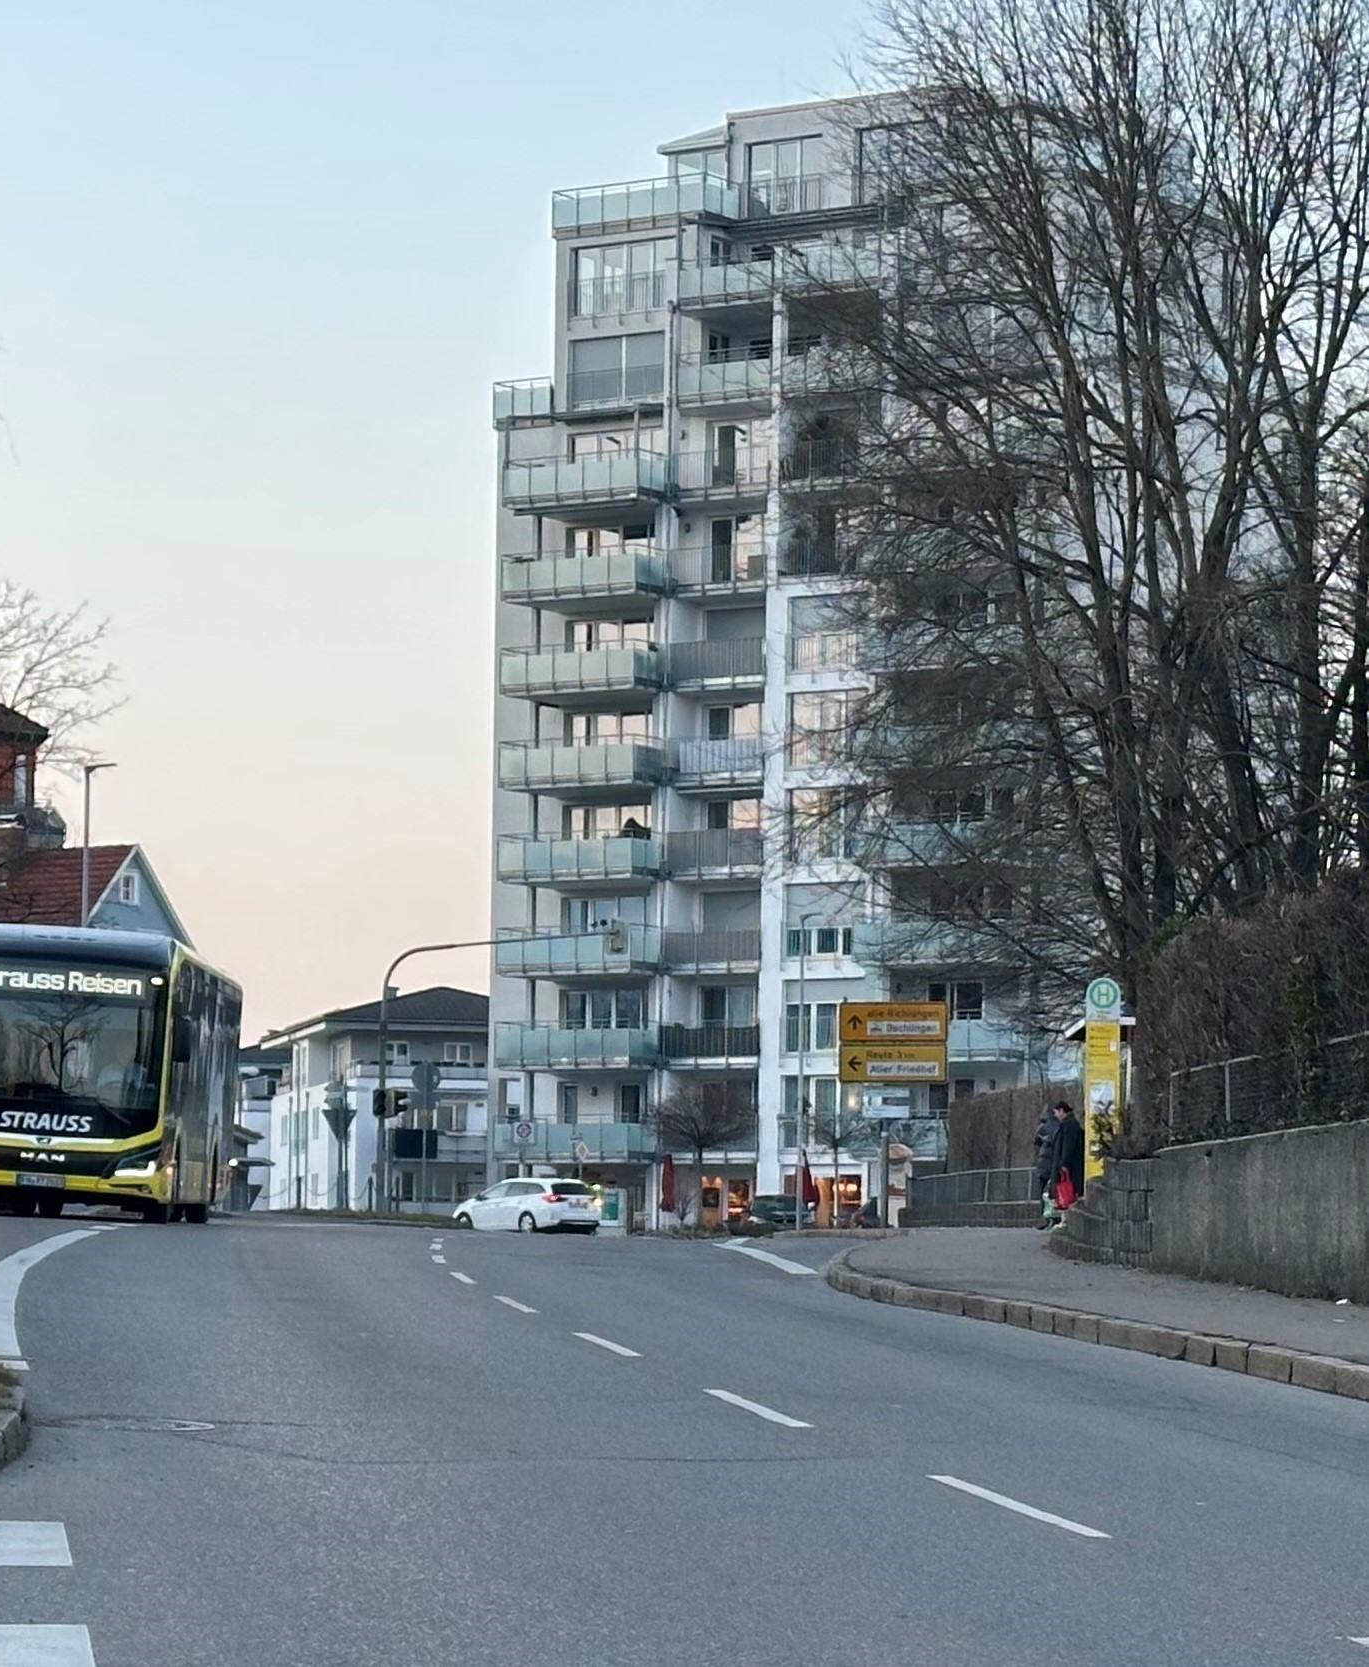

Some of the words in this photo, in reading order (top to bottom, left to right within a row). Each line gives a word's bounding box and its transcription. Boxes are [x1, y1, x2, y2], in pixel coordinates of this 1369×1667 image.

[68, 971, 142, 996] Reisen
[1097, 986, 1110, 1002] H
[896, 1064, 936, 1074] Friedhof
[0, 1110, 94, 1133] STRAUSS
[20, 1151, 66, 1163] MAN
